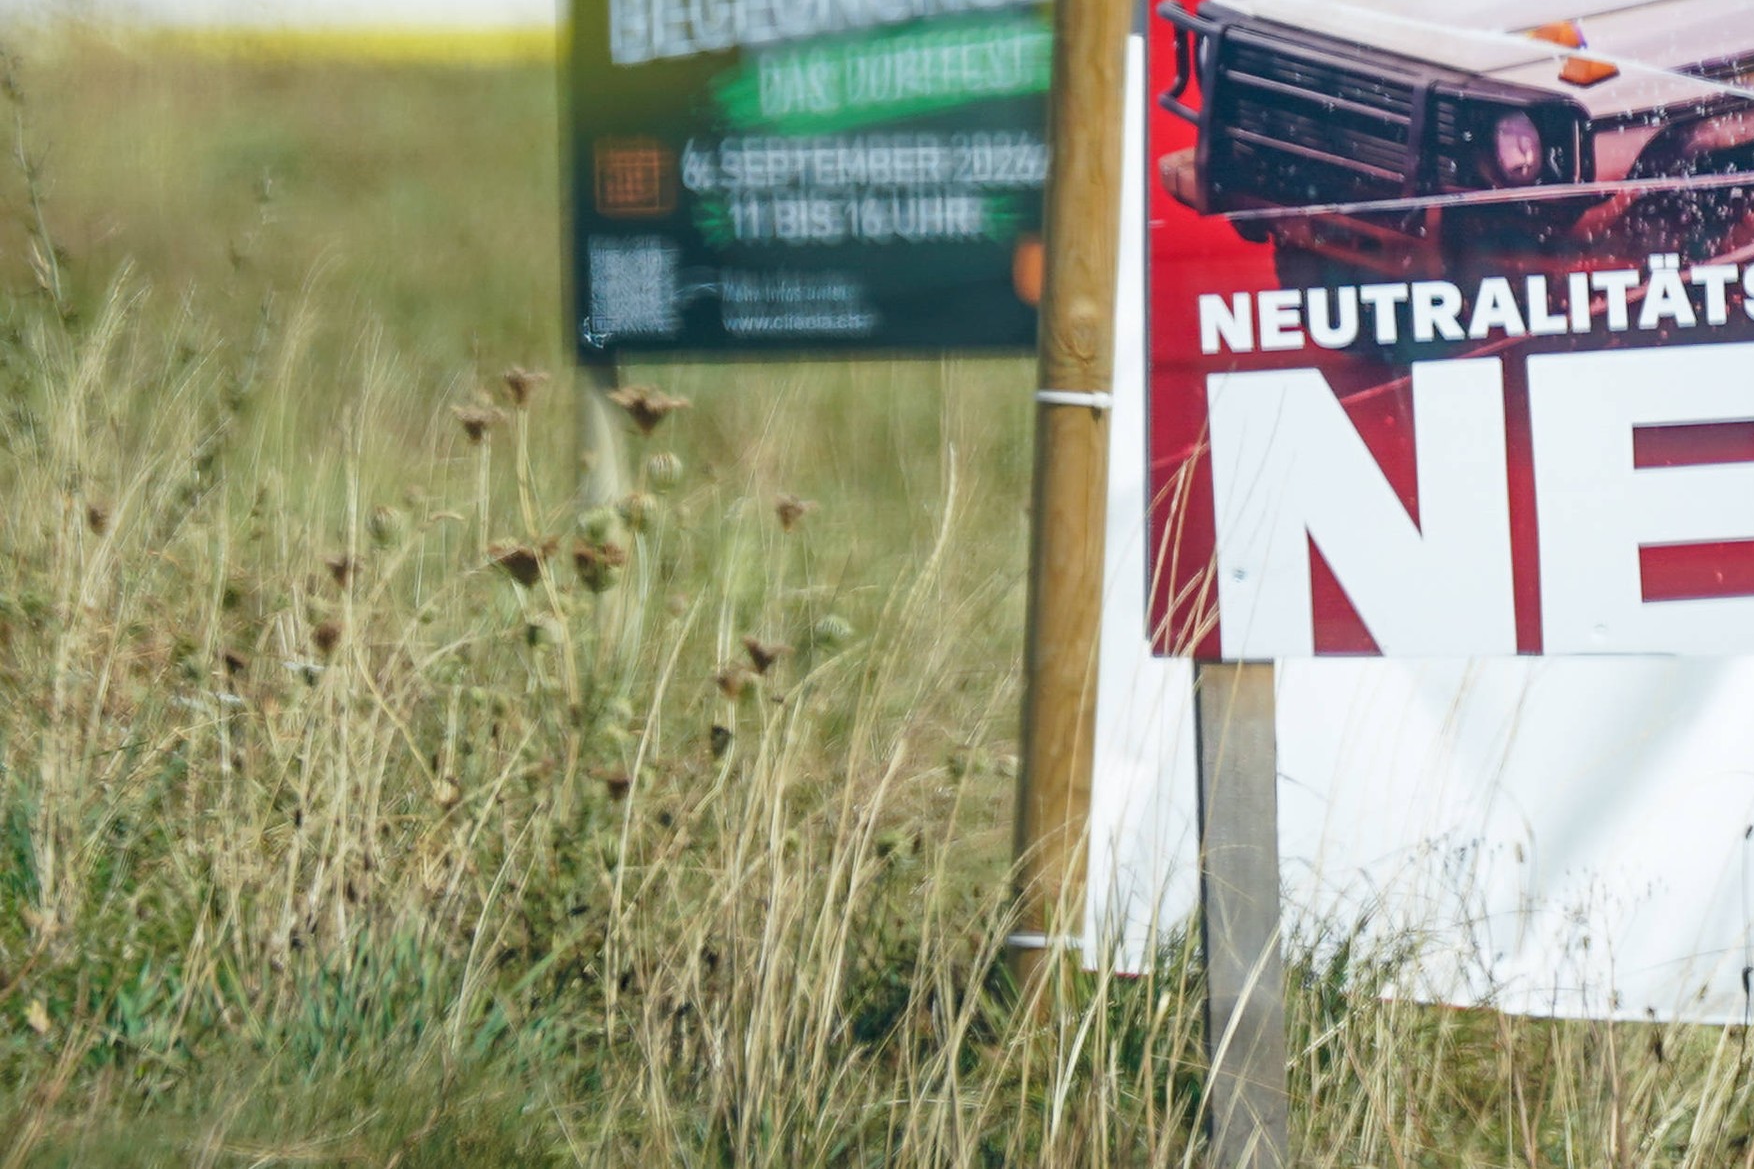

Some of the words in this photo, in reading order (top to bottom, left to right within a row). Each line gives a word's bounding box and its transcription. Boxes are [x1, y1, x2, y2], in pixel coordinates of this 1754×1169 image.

[719, 137, 940, 188] SEPTEMBER
[773, 197, 837, 238] BIS
[892, 193, 976, 237] UHR
